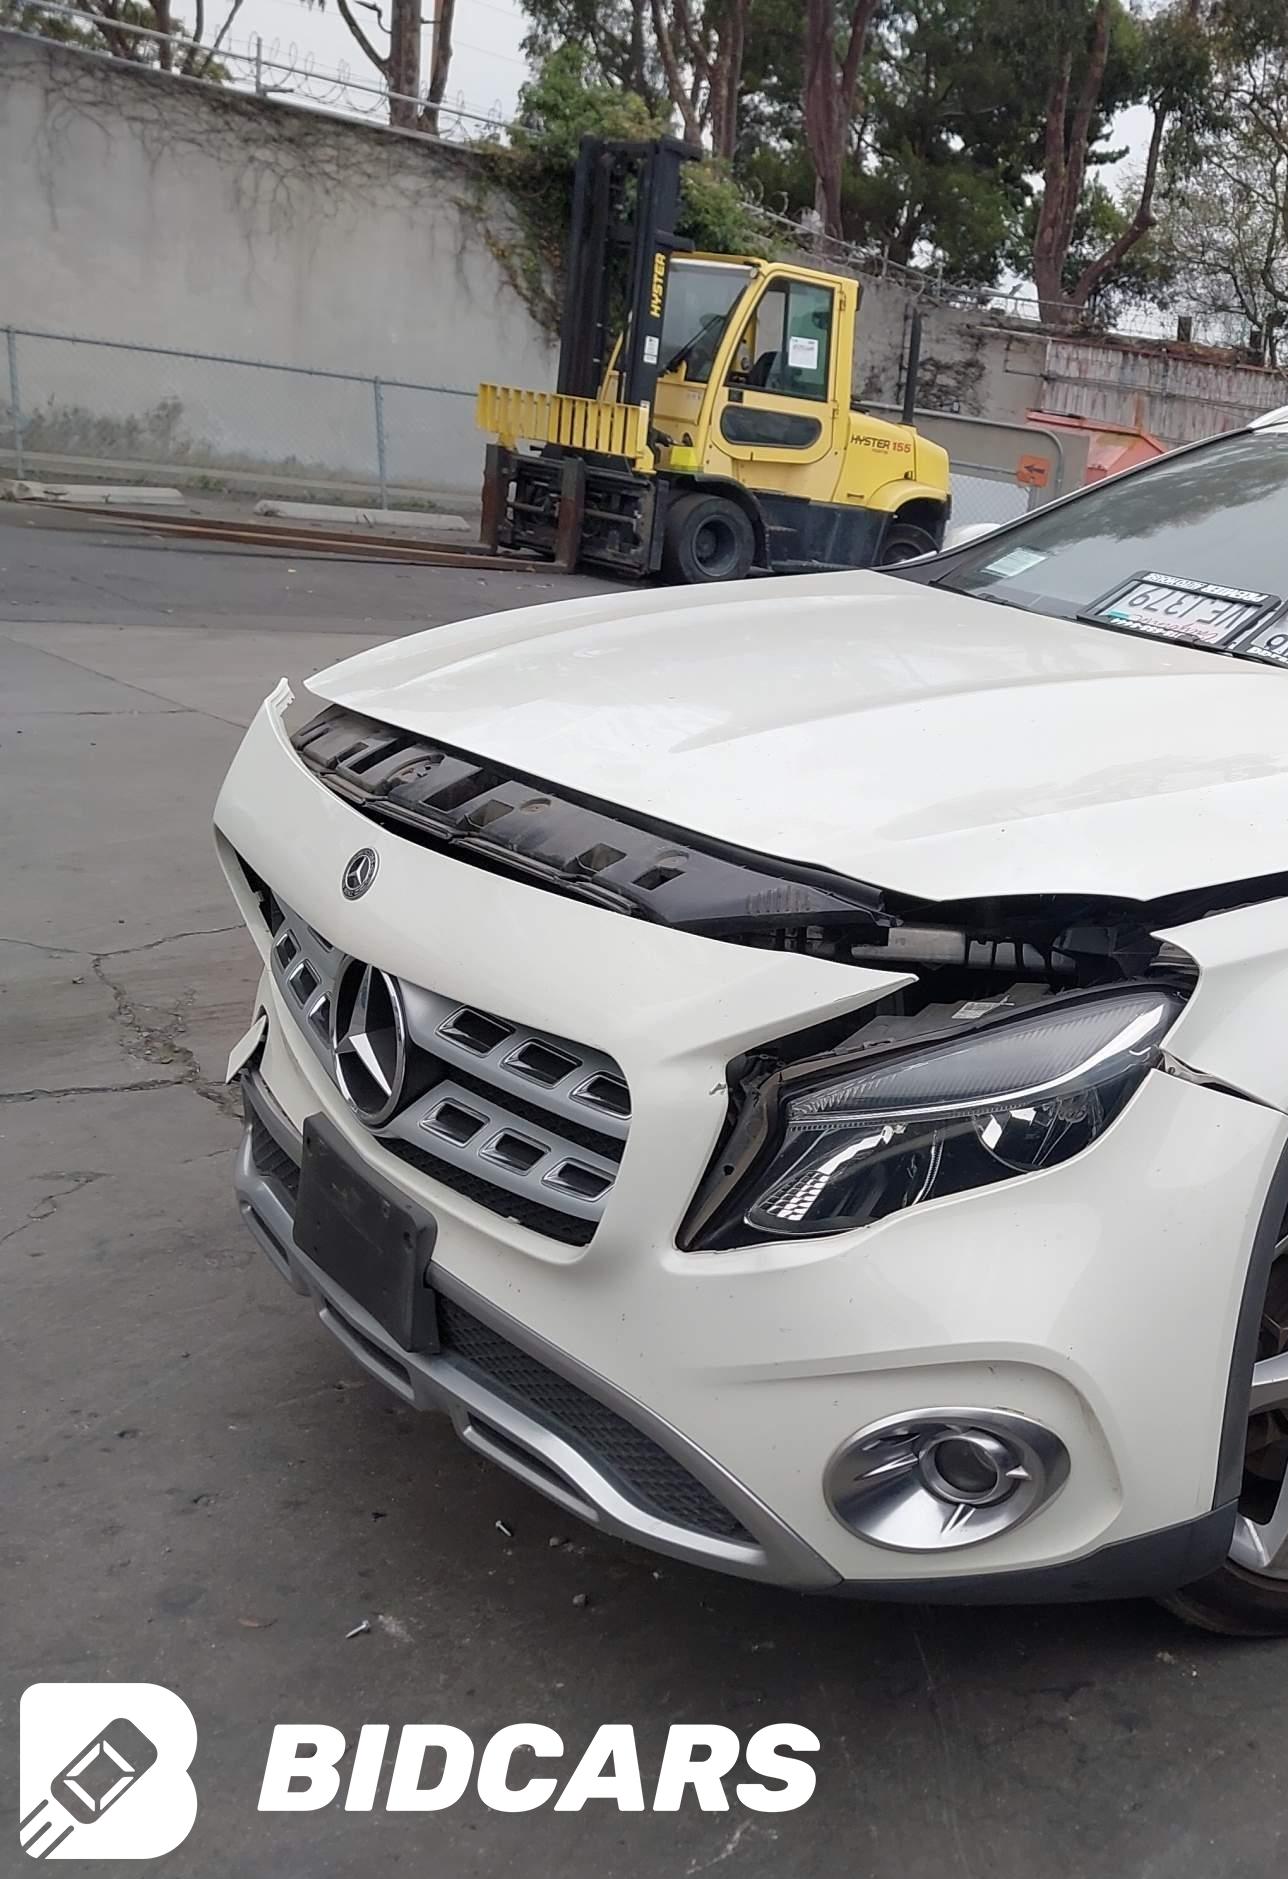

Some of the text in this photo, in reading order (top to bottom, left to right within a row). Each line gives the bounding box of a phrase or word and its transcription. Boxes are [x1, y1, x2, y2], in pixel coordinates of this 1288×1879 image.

[650, 252, 667, 318] HYSTER
[850, 434, 891, 449] HYSTER
[892, 440, 912, 454] 155
[1128, 587, 1247, 629] VEJ379
